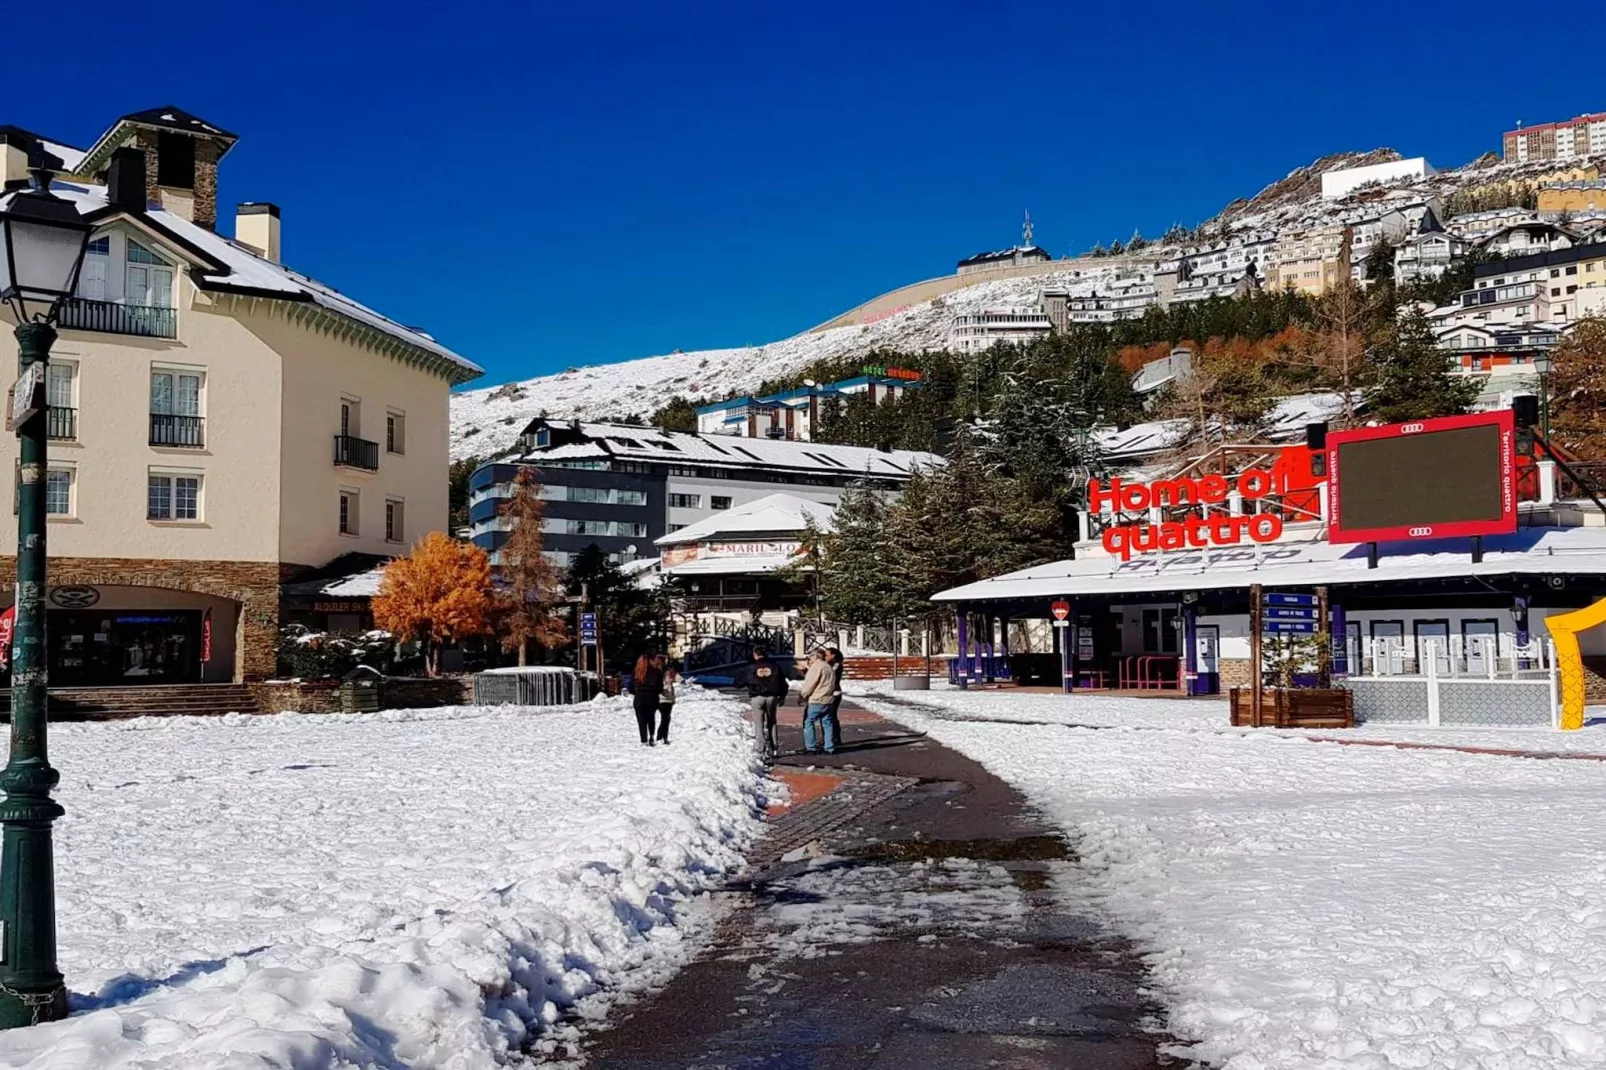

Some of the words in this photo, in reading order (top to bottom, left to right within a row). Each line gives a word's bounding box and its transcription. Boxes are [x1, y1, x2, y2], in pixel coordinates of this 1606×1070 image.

[1330, 450, 1338, 485] quattro
[1502, 430, 1511, 475] Territorio
[1088, 473, 1228, 514] Home
[1330, 485, 1338, 526] Territorio
[1502, 476, 1511, 513] quattro
[1102, 511, 1283, 562] quattro
